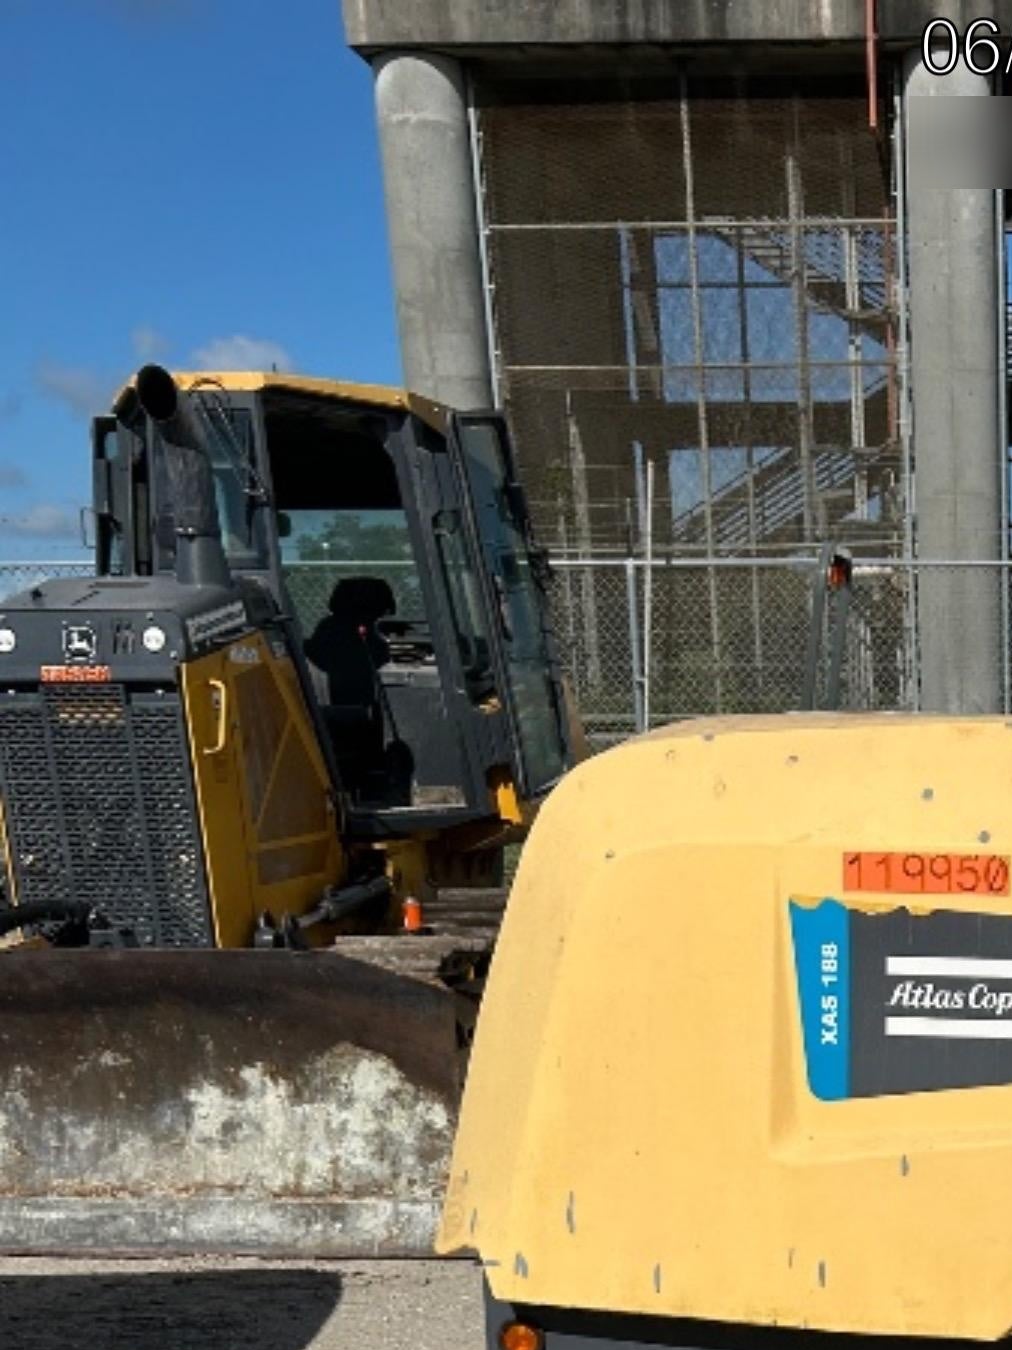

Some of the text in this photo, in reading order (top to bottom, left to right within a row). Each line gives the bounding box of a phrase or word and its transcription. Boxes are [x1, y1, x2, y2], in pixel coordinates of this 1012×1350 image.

[847, 852, 1010, 893] 119950
[821, 942, 838, 1045] XAS 188
[886, 980, 967, 1009] Atlas
